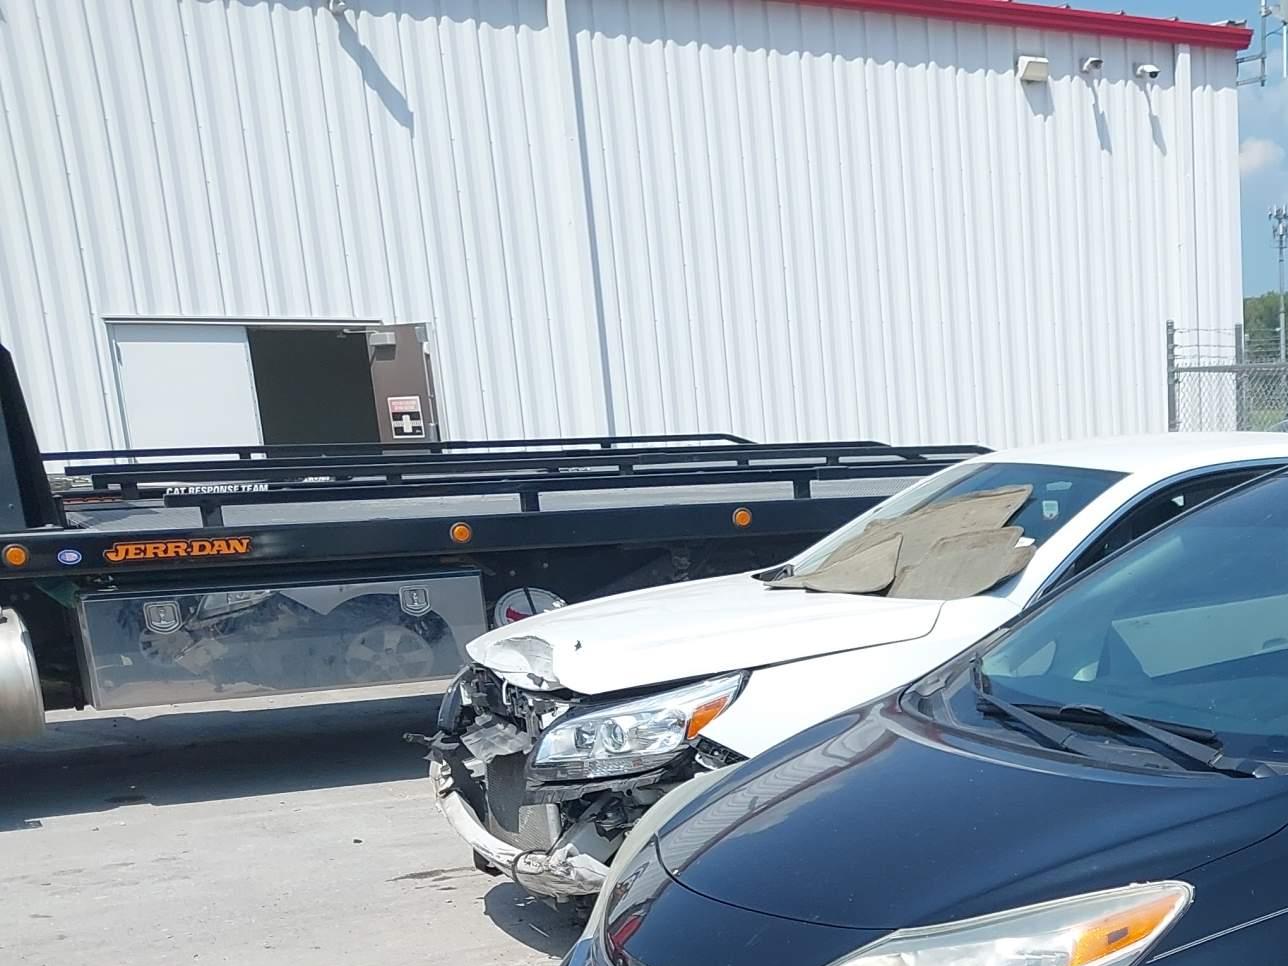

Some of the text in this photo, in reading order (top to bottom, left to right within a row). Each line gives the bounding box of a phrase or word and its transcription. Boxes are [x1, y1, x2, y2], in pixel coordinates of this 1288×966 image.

[166, 483, 269, 495] CAT RESPONSE TEAM
[105, 538, 250, 562] JERR-DAN
